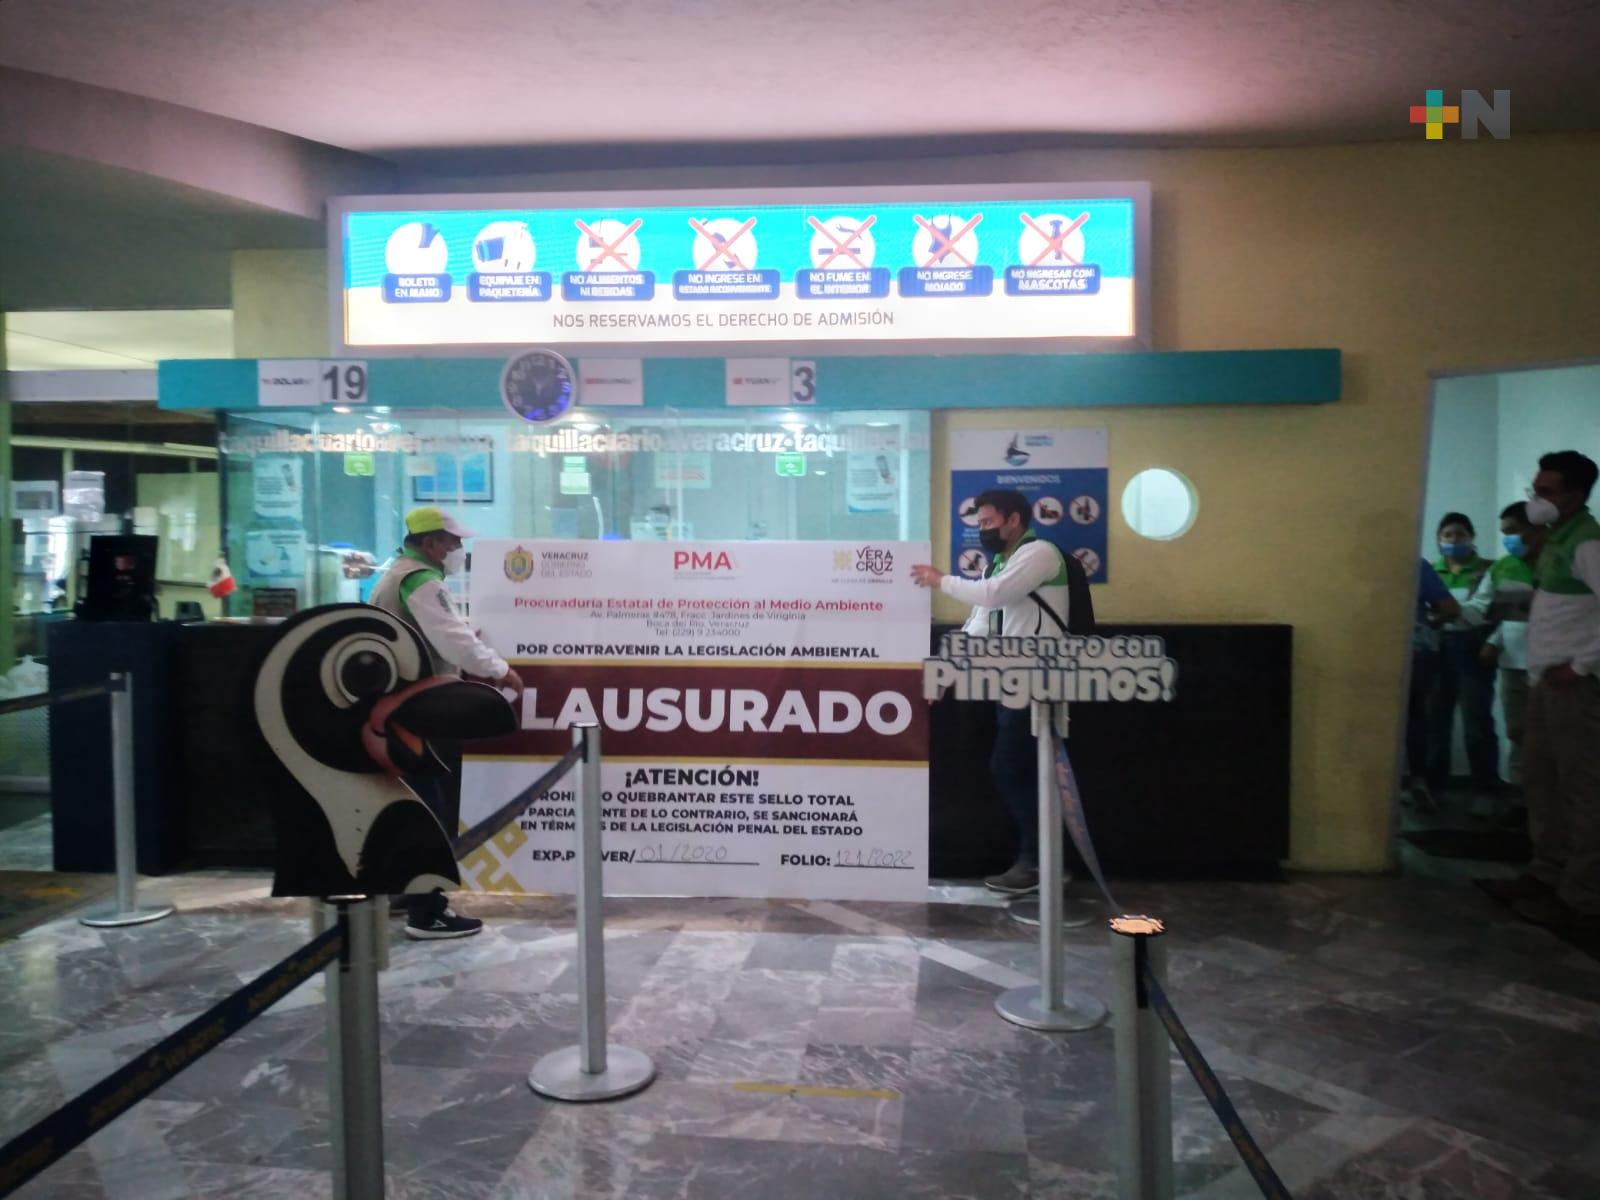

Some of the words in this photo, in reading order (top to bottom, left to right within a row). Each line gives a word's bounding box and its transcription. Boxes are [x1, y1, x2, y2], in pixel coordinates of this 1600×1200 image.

[478, 275, 524, 287] EQUIPAJE
[525, 274, 542, 286] EN
[569, 274, 585, 285] NO
[586, 273, 644, 285] ALIMENTOS
[688, 273, 703, 284] NO
[704, 273, 745, 284] INGRESE
[746, 272, 762, 283] EN
[809, 271, 825, 283] NO
[826, 271, 854, 283] FUME
[855, 271, 871, 282] EN
[916, 271, 932, 281] NO
[932, 269, 974, 281] INGRESE
[1011, 270, 1026, 280] NO
[1026, 269, 1072, 280] INGRESAR
[1073, 268, 1096, 279] CON
[398, 276, 439, 288] BOLETO
[809, 283, 824, 295] EL
[1018, 279, 1088, 291] MASCOTAS
[394, 287, 409, 298] EN
[580, 286, 591, 297] NI
[552, 313, 585, 328] NOS
[588, 312, 692, 328] RESERVAMOS
[696, 313, 714, 327] EL
[718, 312, 789, 327] DERECHO
[793, 312, 813, 326] DE
[817, 308, 895, 326] ADMISIÓN
[322, 365, 366, 401] 19
[793, 366, 815, 402] 3
[541, 551, 589, 560] VERACRUZ
[673, 551, 733, 570] PMA
[856, 546, 894, 561] VERA
[855, 560, 894, 576] CRUZ
[514, 597, 602, 609] Procuraduría
[607, 598, 653, 609] Estatal
[657, 598, 674, 609] de
[678, 598, 750, 610] Protección
[753, 599, 766, 610] al
[770, 599, 812, 611] Medio
[815, 600, 883, 612] Ambiente
[712, 611, 750, 620] Jardines
[752, 611, 764, 620] de
[516, 642, 549, 656] POR
[552, 643, 660, 657] CONTRAVENIR
[664, 644, 684, 657] LA
[688, 641, 786, 657] LEGISLACIÓN
[790, 645, 880, 658] AMBIENTAL
[939, 633, 1103, 659] ¡Encuentro
[1111, 635, 1162, 657] con
[923, 657, 1178, 709] Pingüinos!
[502, 687, 913, 735] LAUSURADO
[625, 764, 760, 788] ¡ATENCIÓN!
[617, 791, 717, 804] QUEBRANTAR
[720, 793, 755, 805] ESTE
[758, 793, 804, 806] SELLO
[807, 794, 855, 806] TOTAL
[630, 808, 648, 819] DE
[651, 808, 668, 819] LO
[671, 809, 750, 822] CONTRARIO,
[753, 810, 769, 821] SE
[772, 809, 858, 823] SANCIONARÁ
[520, 820, 537, 831] EN
[610, 821, 627, 832] DE
[631, 821, 647, 833] LA
[650, 821, 734, 834] LEGISLACIÓN
[737, 823, 780, 835] PENAL
[783, 824, 808, 835] DEL
[811, 825, 863, 837] ESTADO
[780, 854, 831, 867] FOLIO:
